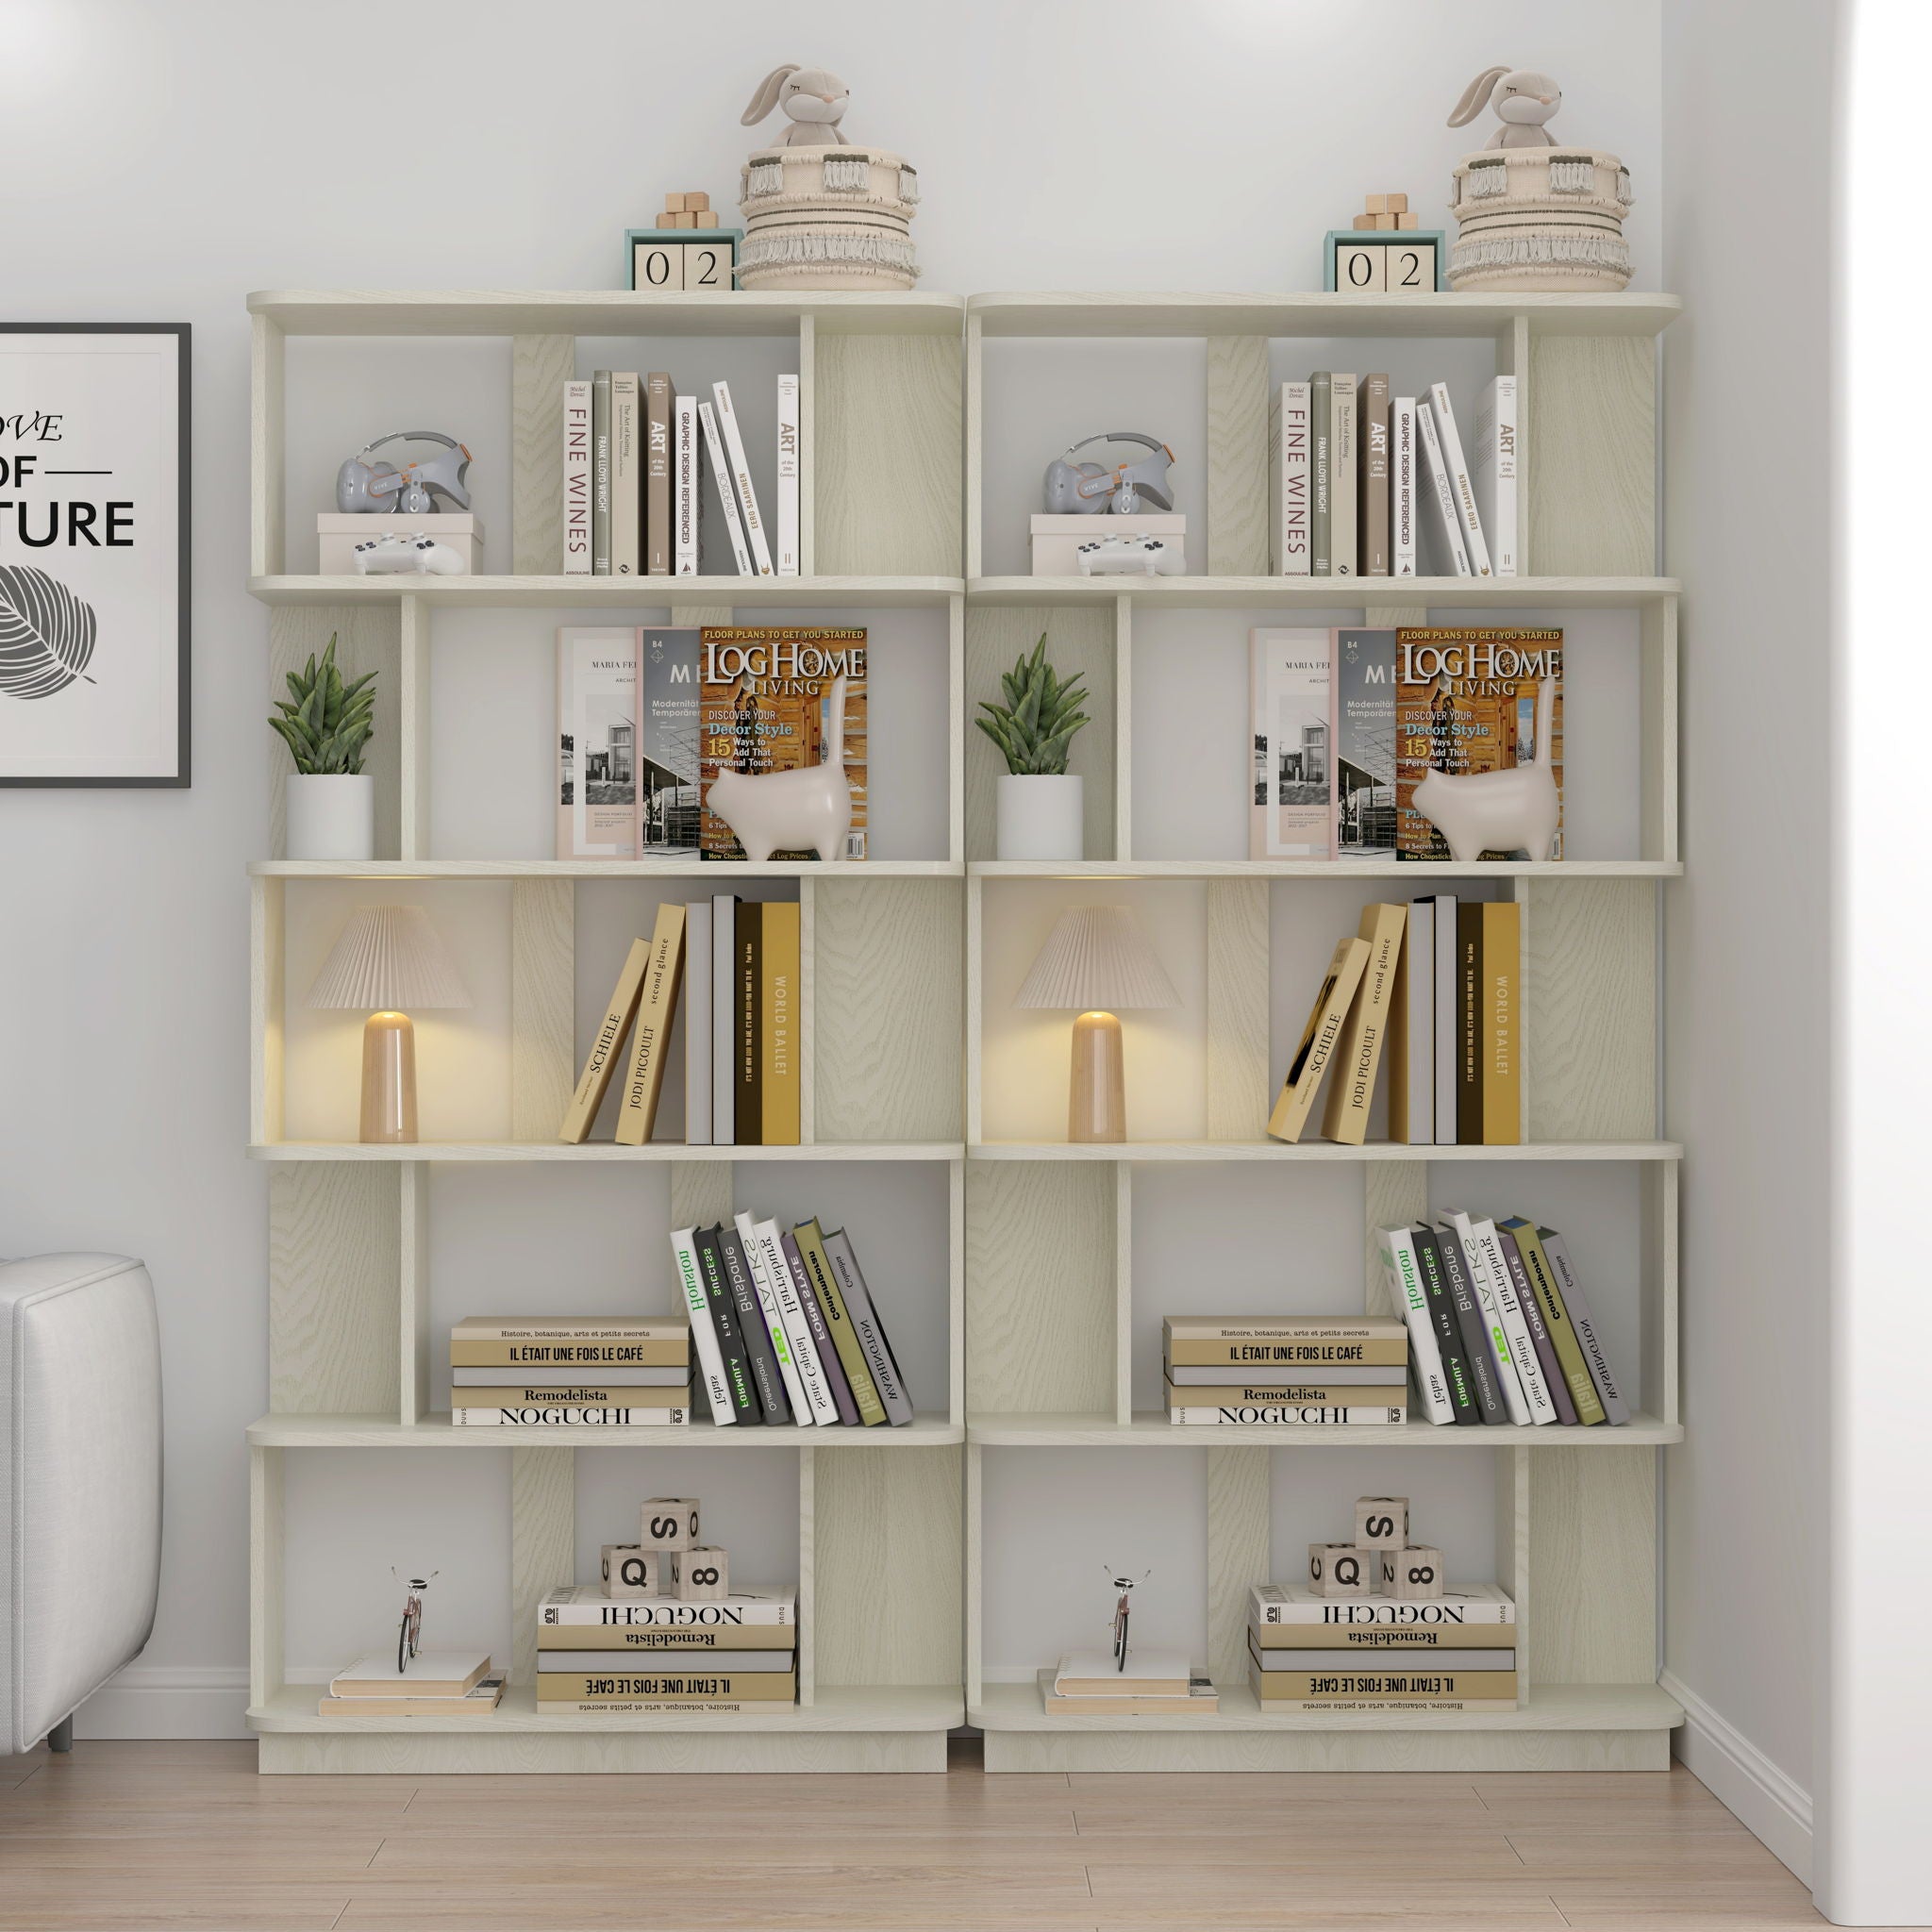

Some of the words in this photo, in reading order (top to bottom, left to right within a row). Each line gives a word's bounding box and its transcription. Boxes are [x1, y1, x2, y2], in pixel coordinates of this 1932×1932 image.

[646, 251, 669, 285] 0
[697, 251, 718, 284] 2
[1348, 253, 1372, 286] 0
[1400, 253, 1421, 285] 2
[0, 410, 62, 441] VE
[569, 408, 586, 461] FINE
[681, 411, 691, 451] GRAPHIC
[1288, 409, 1306, 462] FINE
[1401, 413, 1409, 452] GRAPHIC
[598, 436, 607, 458] FRANK
[623, 434, 631, 458] Knitting
[651, 421, 666, 454] ART
[781, 422, 795, 455] ART
[1371, 422, 1386, 455] ART
[1500, 424, 1514, 456] ART
[0, 456, 37, 488] F
[598, 459, 607, 483] LLOYD
[681, 453, 691, 485] DESIGN
[1401, 455, 1409, 486] DESIGN
[717, 473, 737, 519] BORDEAUX
[739, 473, 754, 509] SAARINEN
[1084, 482, 1099, 491] VIVE
[1436, 474, 1455, 520] BORDEAUX
[598, 485, 607, 513] WRIGHT
[569, 473, 586, 553] WINES
[681, 487, 691, 544] REFERENCED
[748, 510, 759, 529] EERO
[1288, 474, 1306, 554] WINES
[1401, 489, 1409, 545] REFERENCED
[705, 630, 734, 639] FLOOR
[737, 630, 765, 639] PLANS
[768, 630, 780, 639] TO
[782, 630, 800, 639] GET
[803, 630, 821, 639] YOU
[824, 630, 863, 639] STARTED
[1401, 631, 1430, 640] FLOOR
[1433, 631, 1462, 640] PLANS
[1464, 631, 1476, 640] TO
[1479, 631, 1496, 640] GET
[1499, 631, 1517, 640] YOU
[1520, 631, 1559, 640] STARTED
[752, 680, 820, 695] LIVING
[1449, 681, 1516, 696] LIVING
[708, 709, 751, 721] DISCOVER
[754, 709, 776, 721] YOUR
[1347, 700, 1393, 708] Modernität
[1405, 710, 1447, 721] DISCOVER
[1449, 710, 1473, 721] YOUR
[708, 724, 752, 736] Decor
[755, 724, 792, 739] Style
[733, 738, 755, 747] Ways
[758, 738, 766, 746] to
[1405, 724, 1448, 736] Decor
[1451, 724, 1489, 740] Style
[708, 738, 731, 757] 15
[733, 748, 750, 757] Add
[753, 748, 772, 757] That
[1405, 739, 1428, 758] 15
[1429, 749, 1446, 758] Add
[1449, 749, 1468, 758] That
[708, 758, 746, 767] Personal
[749, 758, 774, 767] Touch
[1406, 758, 1442, 767] Personal
[1445, 758, 1470, 767] Touch
[651, 971, 662, 1005] second
[658, 938, 669, 970] glance
[1374, 971, 1384, 1005] second
[1379, 938, 1391, 970] glance
[774, 975, 787, 1024] WORLD
[1496, 975, 1508, 1024] WORLD
[590, 1013, 622, 1074] SCHIELE
[635, 1025, 655, 1078] PICOULT
[774, 1029, 787, 1075] BALLET
[1309, 1013, 1341, 1074] SCHIELE
[1357, 1025, 1376, 1078] PICOULT
[1496, 1029, 1508, 1075] BALLET
[630, 1080, 644, 1109] JODI
[1352, 1080, 1366, 1109] JODI
[509, 1347, 520, 1360] IL
[522, 1344, 551, 1360] ÉTAIT
[553, 1347, 574, 1360] UNE
[576, 1347, 599, 1360] FOIS
[602, 1347, 614, 1360] LE
[616, 1344, 643, 1360] CAFÉ
[1230, 1346, 1240, 1359] IL
[1242, 1344, 1272, 1359] ÉTAIT
[1274, 1346, 1293, 1359] UNE
[1296, 1346, 1319, 1359] FOIS
[1322, 1346, 1334, 1359] LE
[1337, 1344, 1363, 1359] CAFÉ
[525, 1390, 608, 1401] Remodelista
[1243, 1389, 1326, 1400] Remodelista
[499, 1407, 631, 1424] NOGUCHI
[1218, 1407, 1348, 1424] NOGUCHI
[650, 1516, 677, 1539] S
[1366, 1515, 1393, 1538] S
[621, 1558, 647, 1588] Q
[691, 1567, 719, 1586] 8
[1335, 1557, 1360, 1587] Q
[1408, 1566, 1434, 1585] 8
[601, 1607, 743, 1624] NOGUCHI
[1323, 1606, 1464, 1624] NOGUCHI
[625, 1634, 716, 1646] Remodelista
[1348, 1632, 1438, 1644] Remodelista
[586, 1679, 614, 1696] CAFÉ
[617, 1679, 630, 1693] LE
[633, 1679, 658, 1693] FOIS
[661, 1679, 683, 1693] UNE
[686, 1679, 717, 1696] ÉTAIT
[720, 1679, 730, 1693] IL
